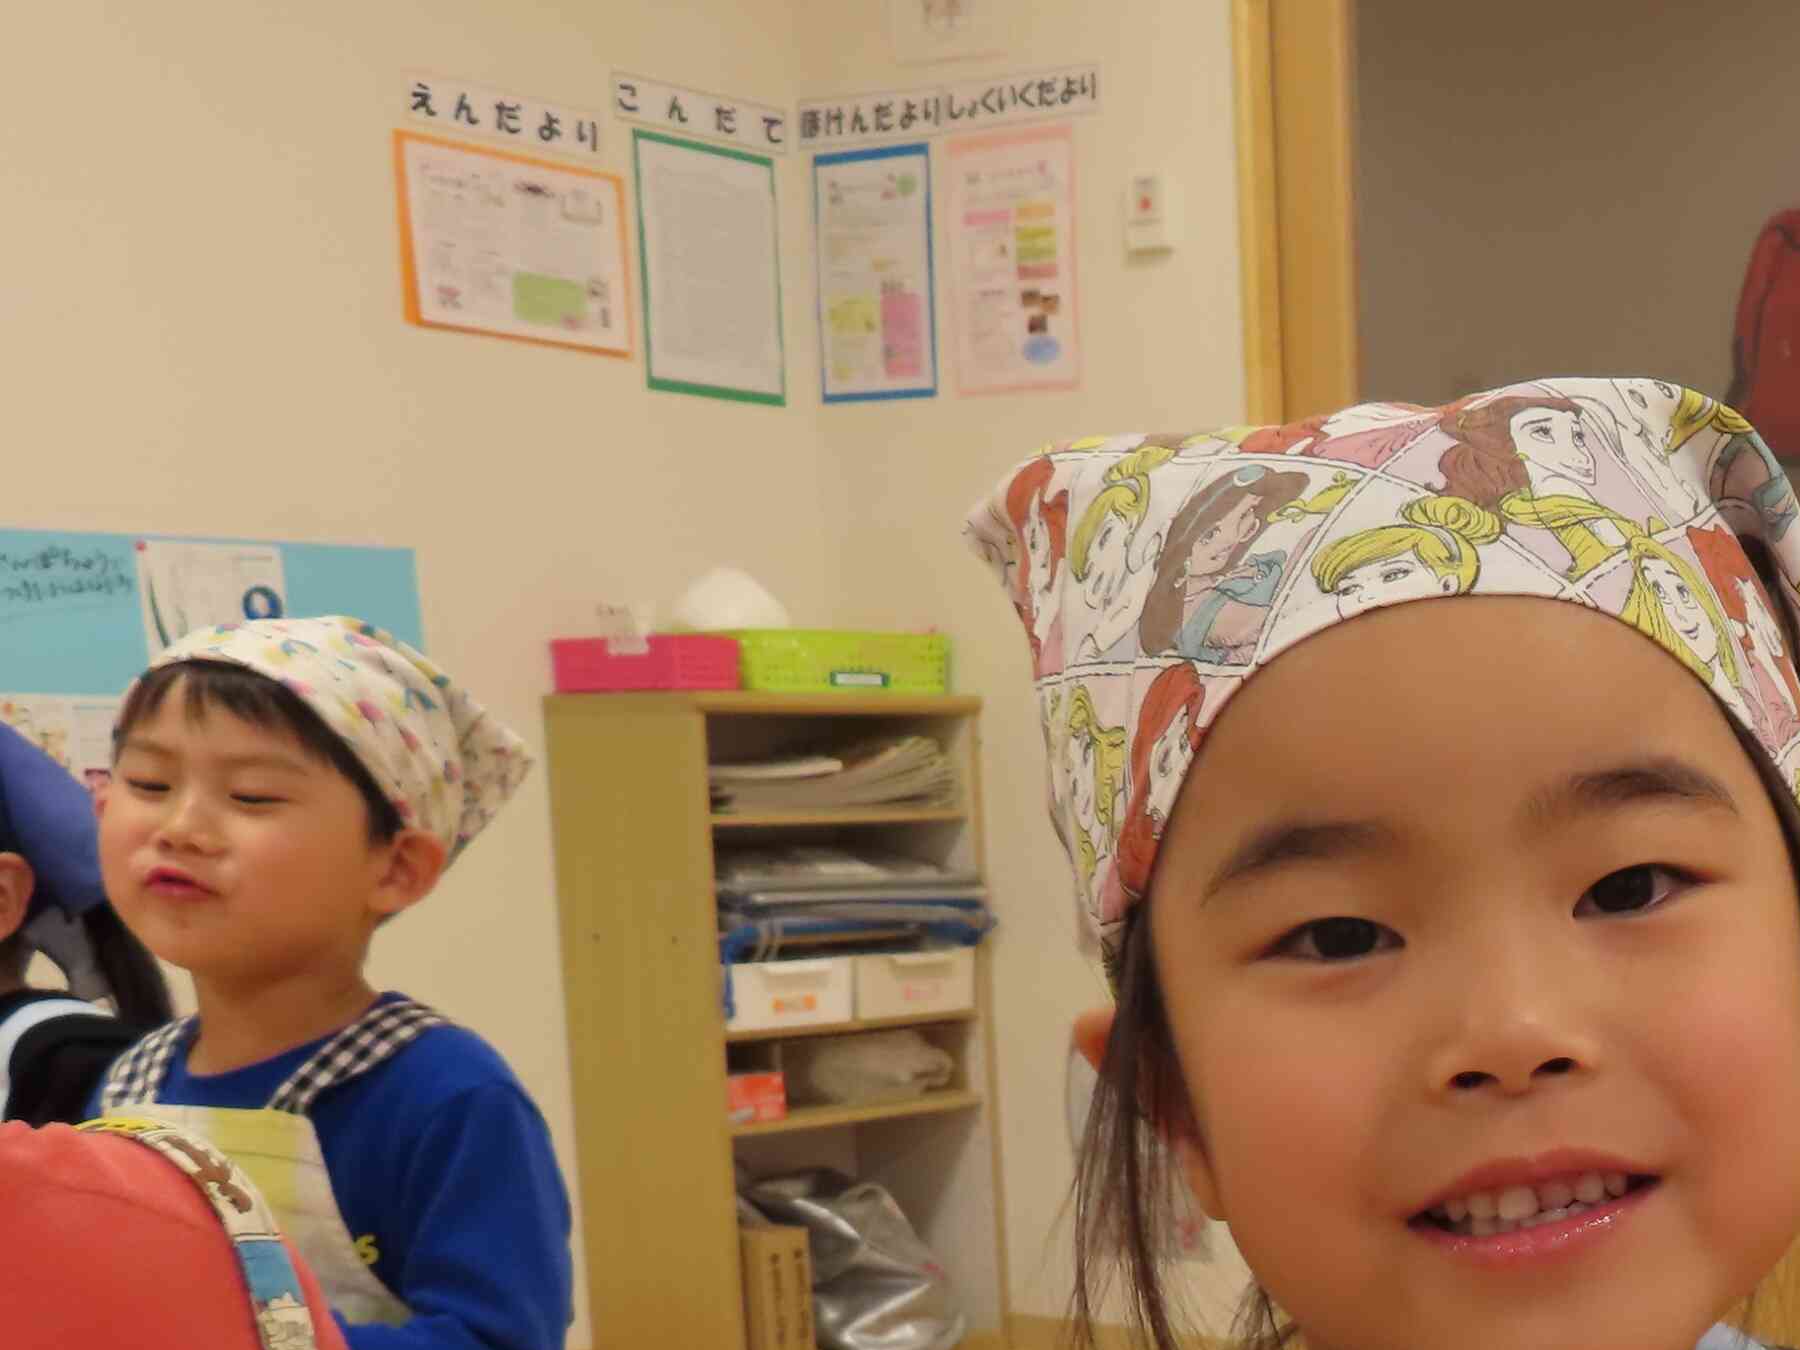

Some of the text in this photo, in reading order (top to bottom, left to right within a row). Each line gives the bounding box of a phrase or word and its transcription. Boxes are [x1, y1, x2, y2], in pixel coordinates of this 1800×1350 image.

[410, 81, 598, 153] えんだより
[618, 82, 785, 144] こんだて
[948, 71, 1097, 121] しょくいくだより
